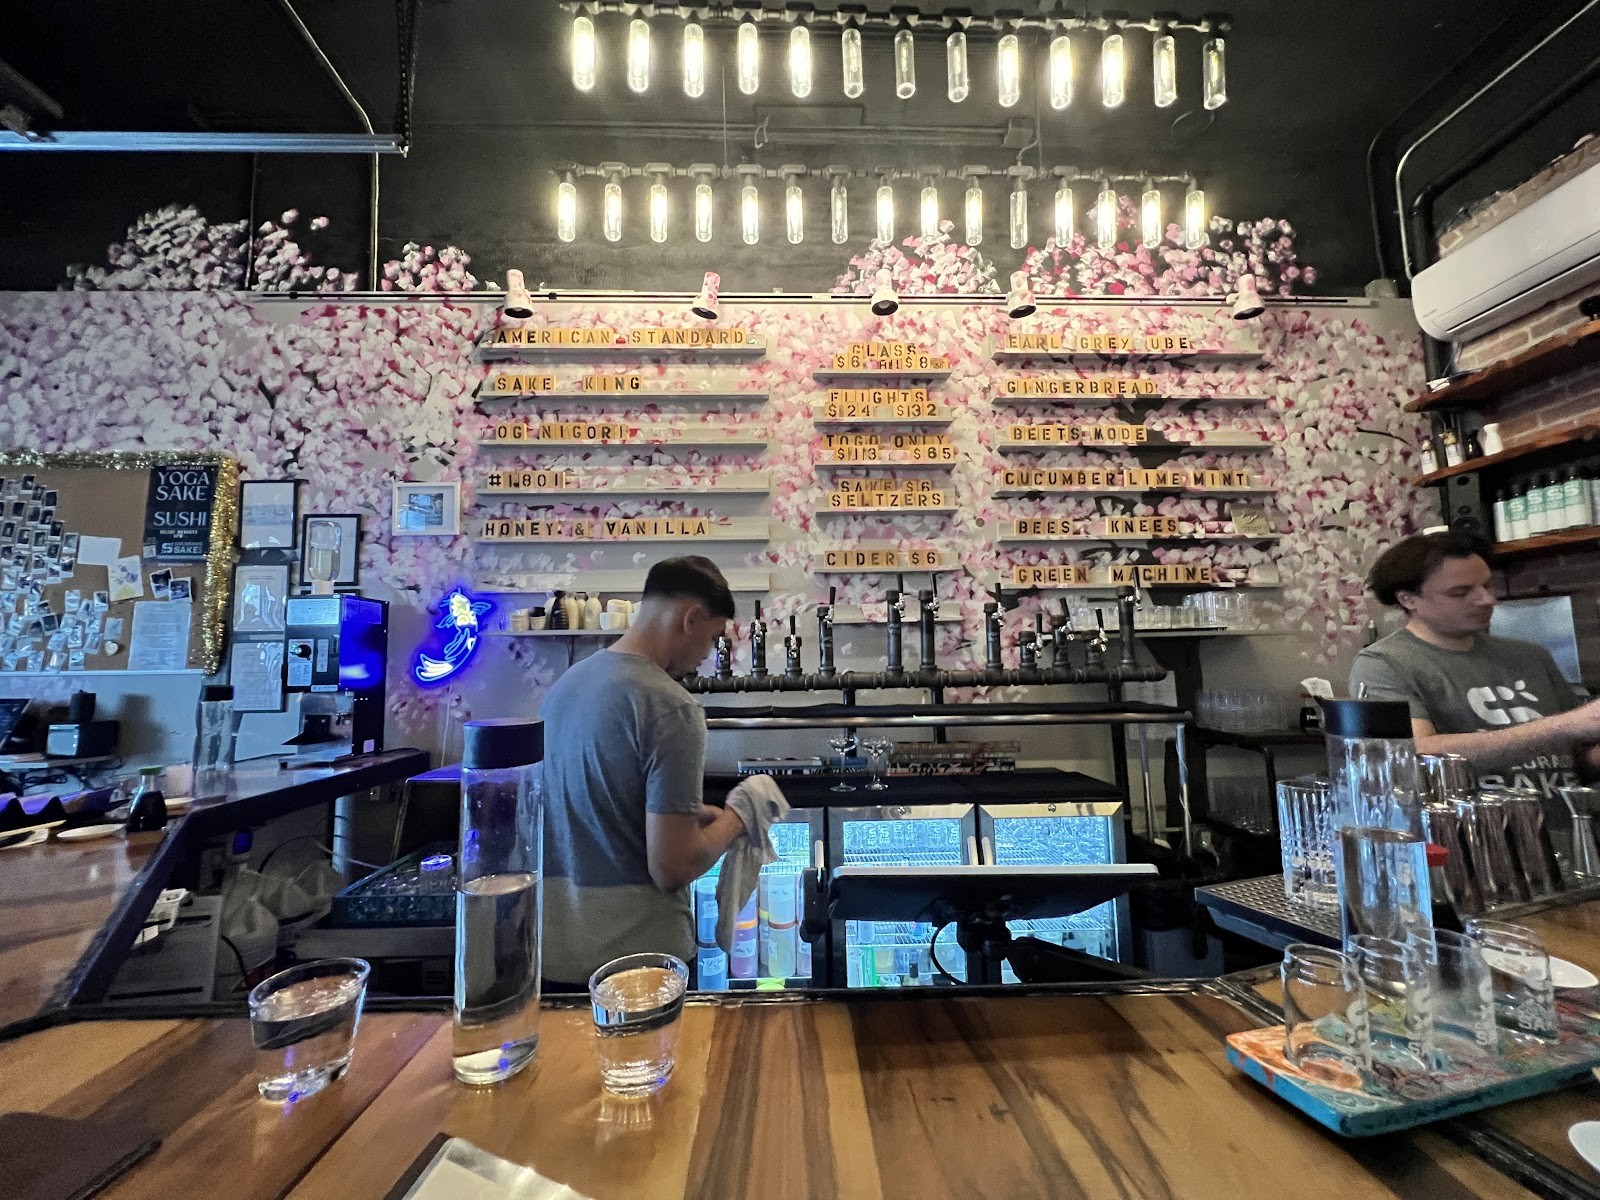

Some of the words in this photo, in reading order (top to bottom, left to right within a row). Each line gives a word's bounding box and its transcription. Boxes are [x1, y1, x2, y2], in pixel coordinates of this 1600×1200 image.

[498, 330, 610, 344] AMERICAN
[632, 330, 744, 344] STANDARD
[1009, 337, 1059, 350] EARL
[1080, 337, 1129, 350] GREY
[1151, 337, 1189, 350] UBE
[852, 344, 916, 358] GLASS
[837, 355, 860, 369] $6
[905, 356, 928, 369] $8
[497, 377, 552, 390] SAKE
[585, 376, 640, 390] KING
[1007, 380, 1154, 394] GINGERBREAD
[830, 391, 924, 404] FLIGHTS
[498, 426, 523, 439] OG
[542, 425, 624, 439] NIGORI
[1014, 428, 1080, 440] BEETS
[1094, 428, 1145, 440] MODE
[894, 434, 945, 448] ONLY
[913, 447, 951, 460] $65
[158, 471, 210, 485] YOGA
[1005, 472, 1115, 486] CUCUMBER
[1129, 472, 1181, 486] LIME
[1193, 473, 1244, 486] MINT
[156, 485, 207, 500] SAKE
[906, 481, 930, 492] $6
[831, 493, 941, 507] SELTZERS
[153, 511, 206, 526] SUSHI
[486, 522, 554, 536] HONEY
[574, 522, 584, 536] &
[1018, 520, 1071, 534] BEES
[1111, 519, 1177, 533] KNEES
[826, 552, 895, 565] CIDER
[911, 552, 936, 565] $6
[1018, 569, 1089, 582] GREEN
